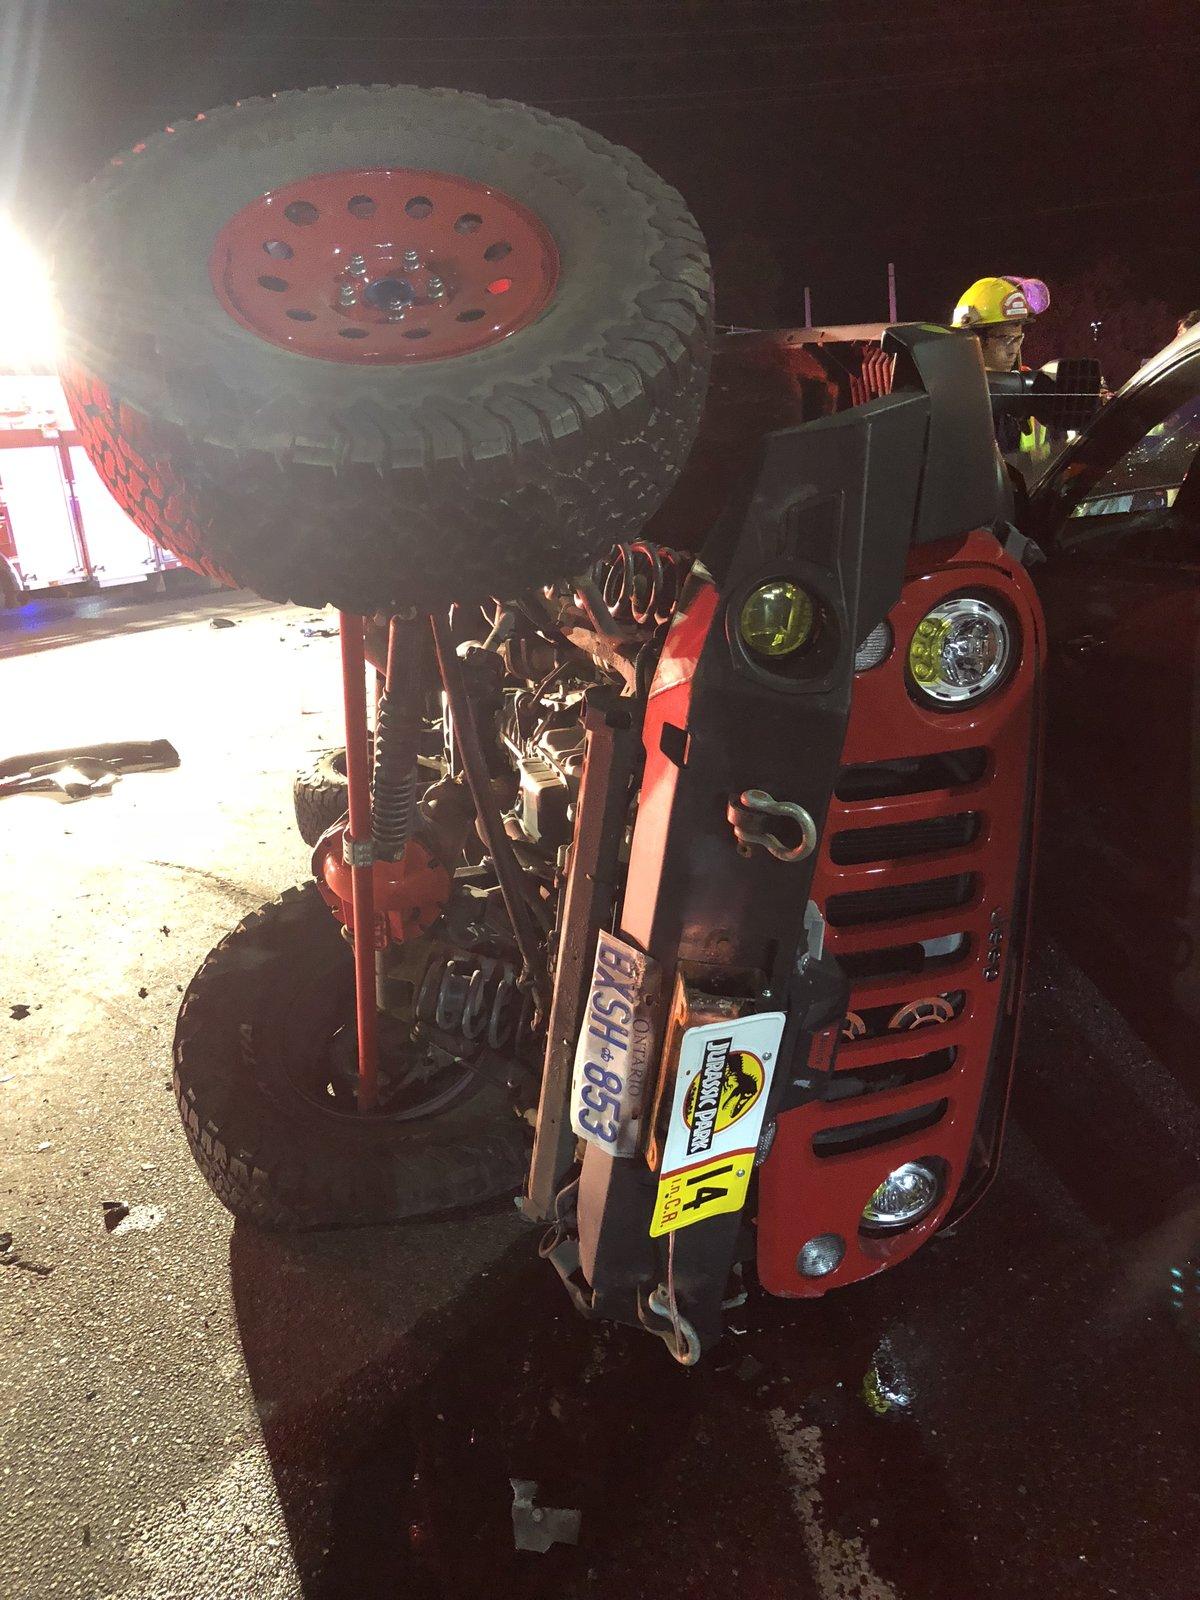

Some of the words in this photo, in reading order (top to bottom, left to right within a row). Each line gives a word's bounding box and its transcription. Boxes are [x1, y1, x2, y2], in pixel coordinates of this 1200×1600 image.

[589, 944, 635, 1051] BXSH
[579, 1062, 623, 1144] 853
[698, 1041, 731, 1111] JURASSIC
[690, 1109, 718, 1154] PARK
[682, 1164, 734, 1212] 14
